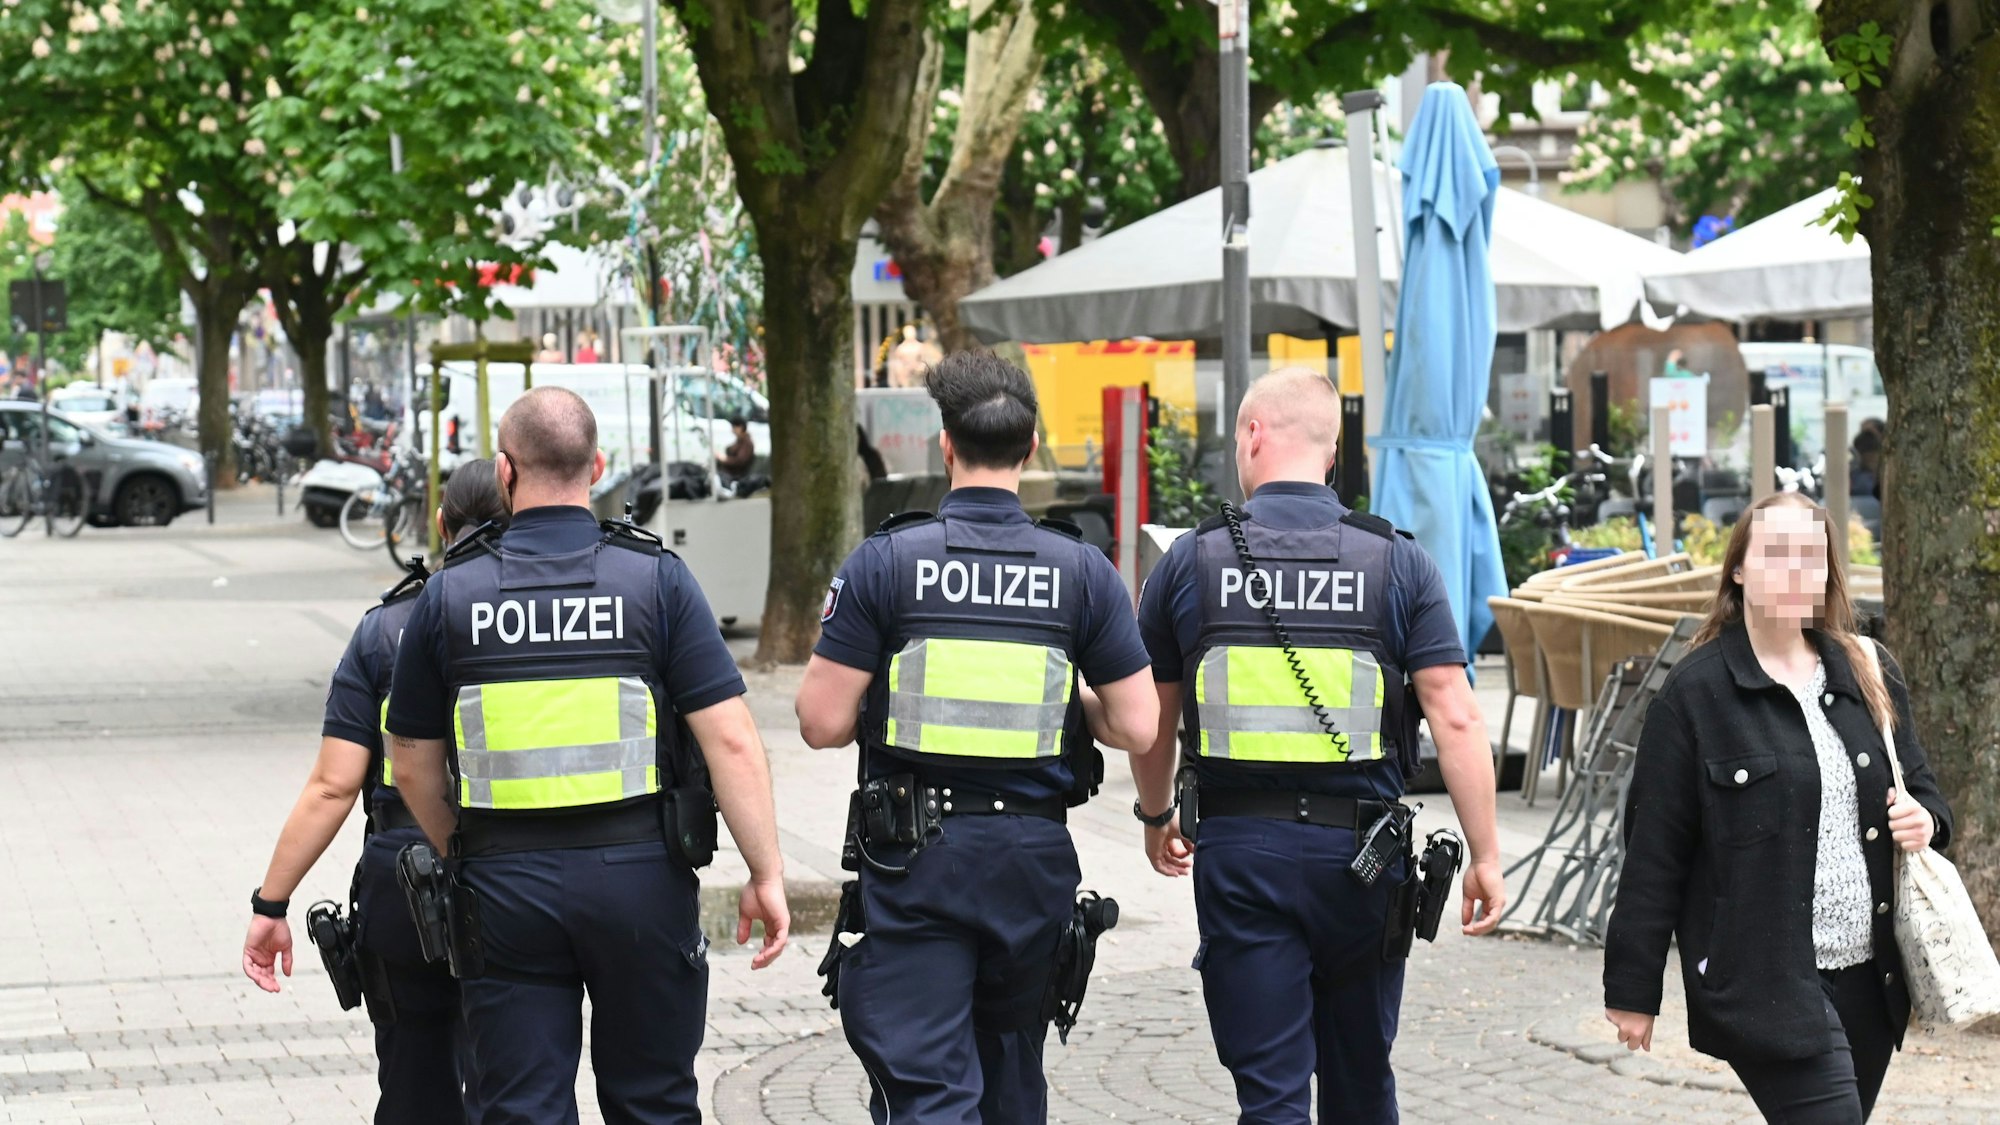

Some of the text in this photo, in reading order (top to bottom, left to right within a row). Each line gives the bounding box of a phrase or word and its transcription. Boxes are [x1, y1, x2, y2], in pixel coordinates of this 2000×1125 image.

[915, 559, 1060, 609] POLIZEI
[1220, 567, 1365, 612] POLIZEI
[471, 596, 624, 646] POLIZEI
